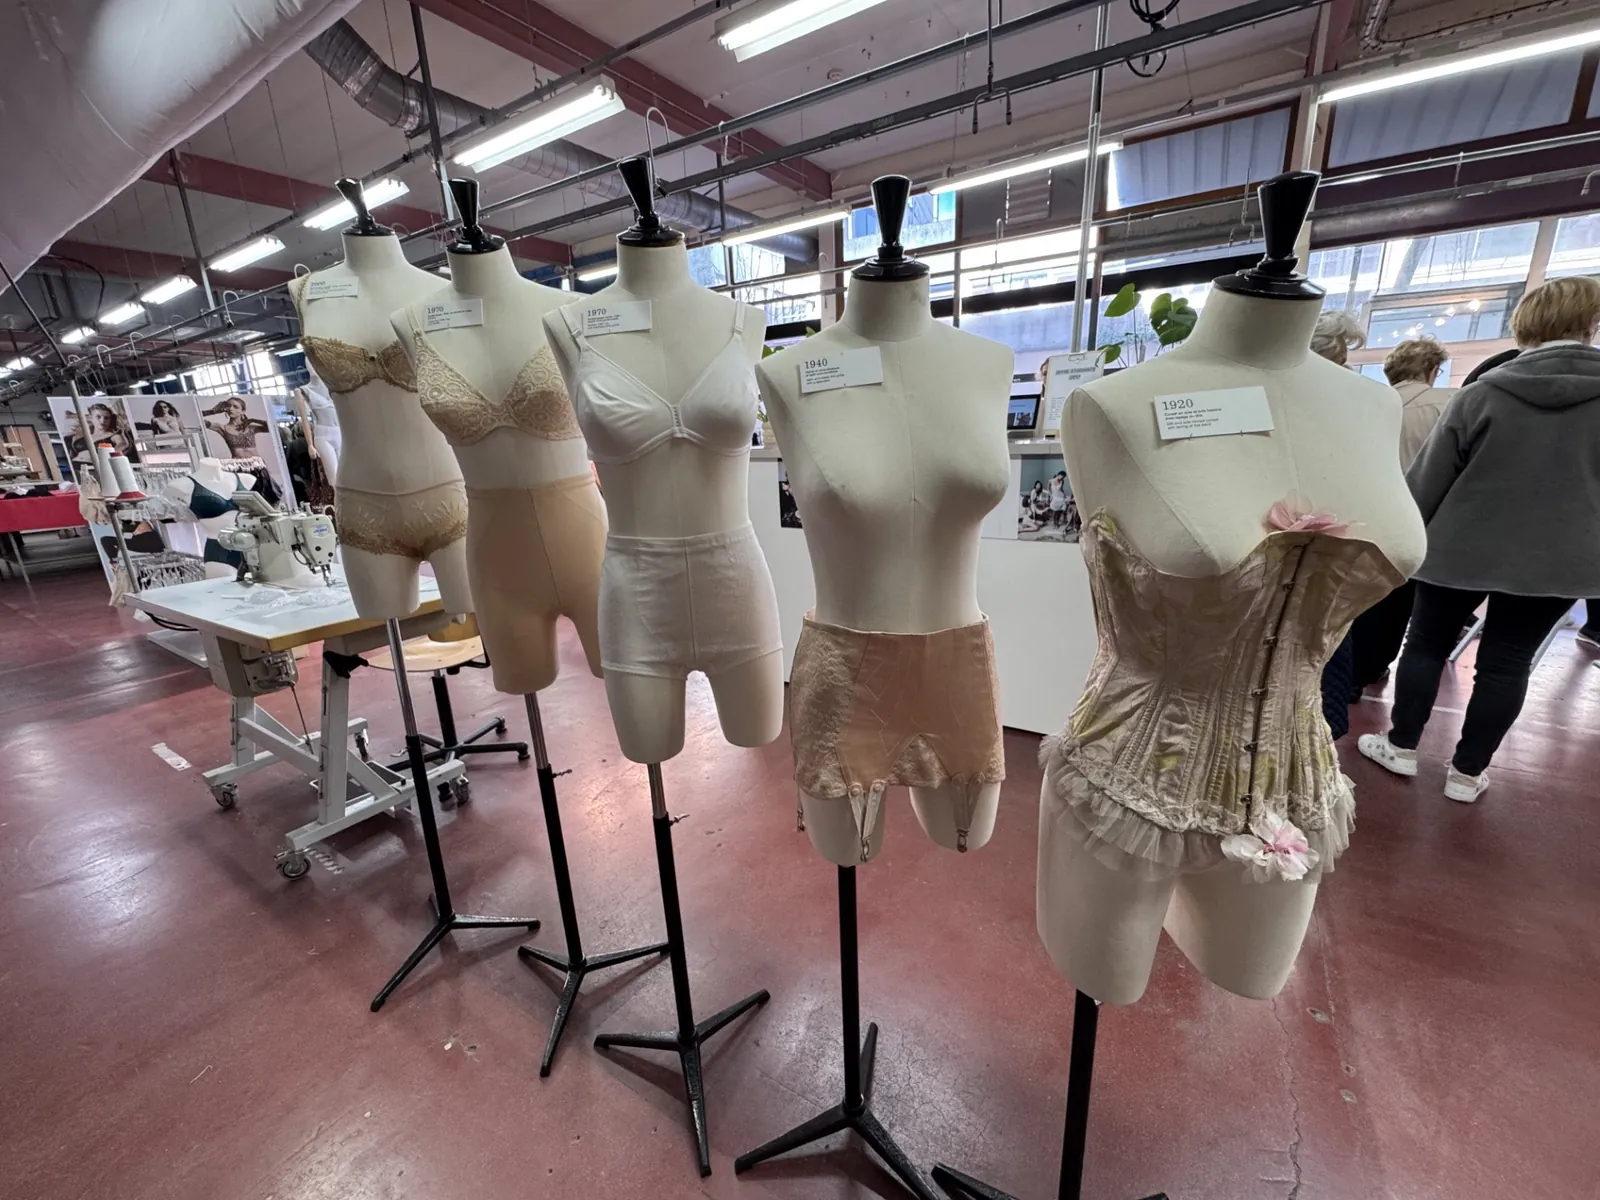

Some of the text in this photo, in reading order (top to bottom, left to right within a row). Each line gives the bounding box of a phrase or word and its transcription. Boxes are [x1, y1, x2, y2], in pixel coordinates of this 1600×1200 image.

[587, 308, 607, 317] 1970
[804, 358, 828, 370] 1940
[1161, 398, 1194, 411] 1920
